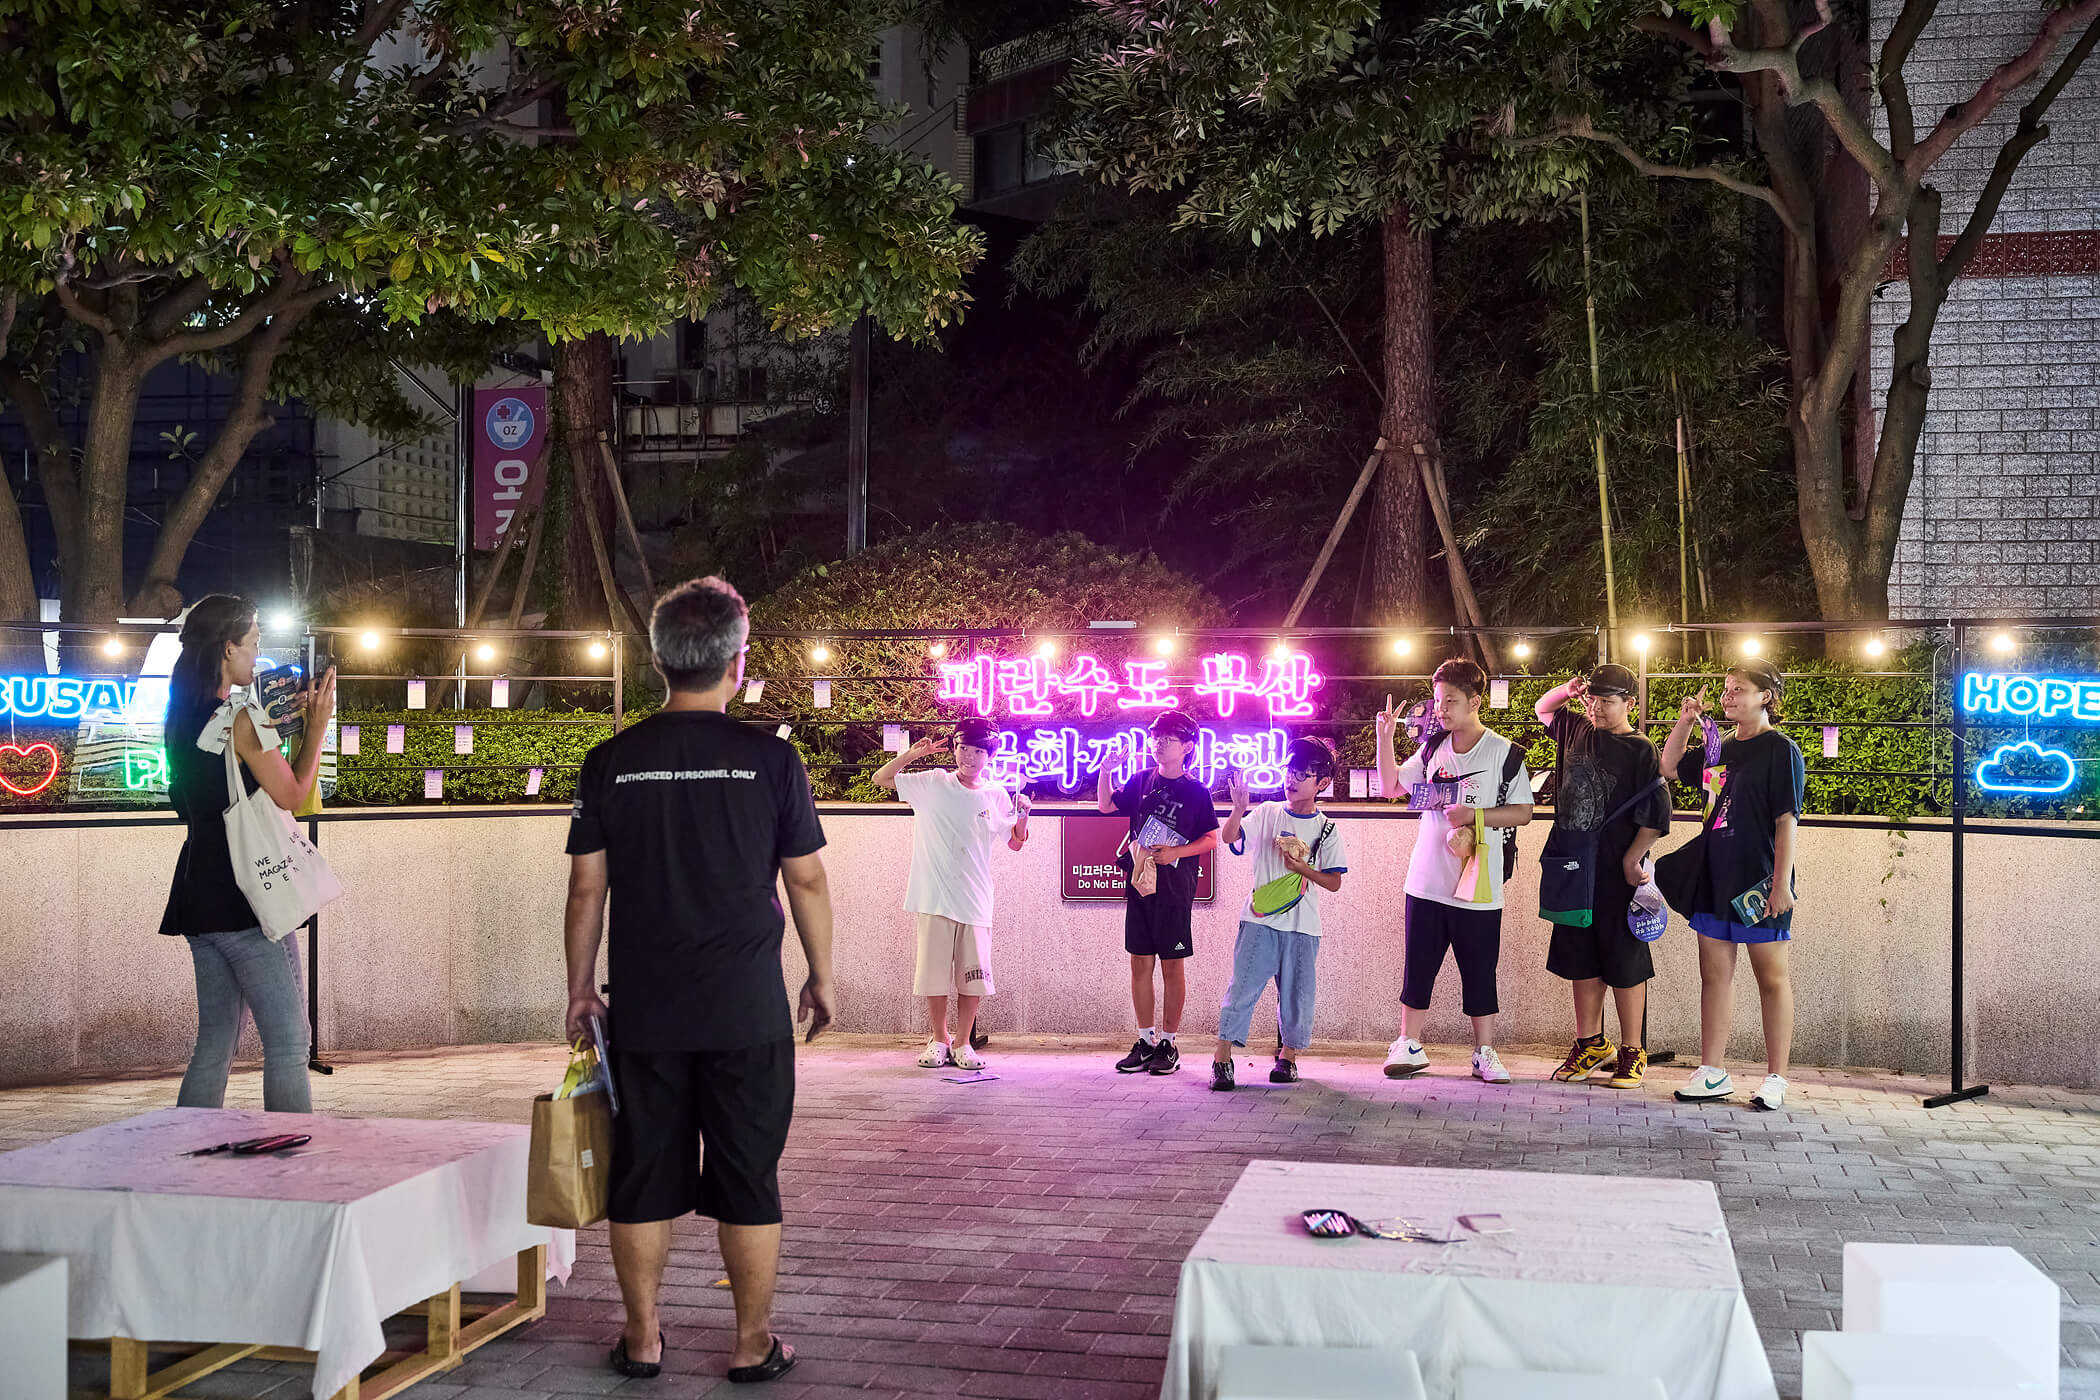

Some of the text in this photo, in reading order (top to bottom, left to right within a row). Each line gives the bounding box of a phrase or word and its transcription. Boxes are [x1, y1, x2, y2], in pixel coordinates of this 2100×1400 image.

[503, 426, 518, 436] OZ
[938, 653, 1321, 717] 피란수도 부산
[1963, 672, 2100, 720] HOPE
[615, 769, 757, 784] AUTHORIZED PERSONNEL ONLY
[1078, 880, 1127, 889] Do Not Ent
